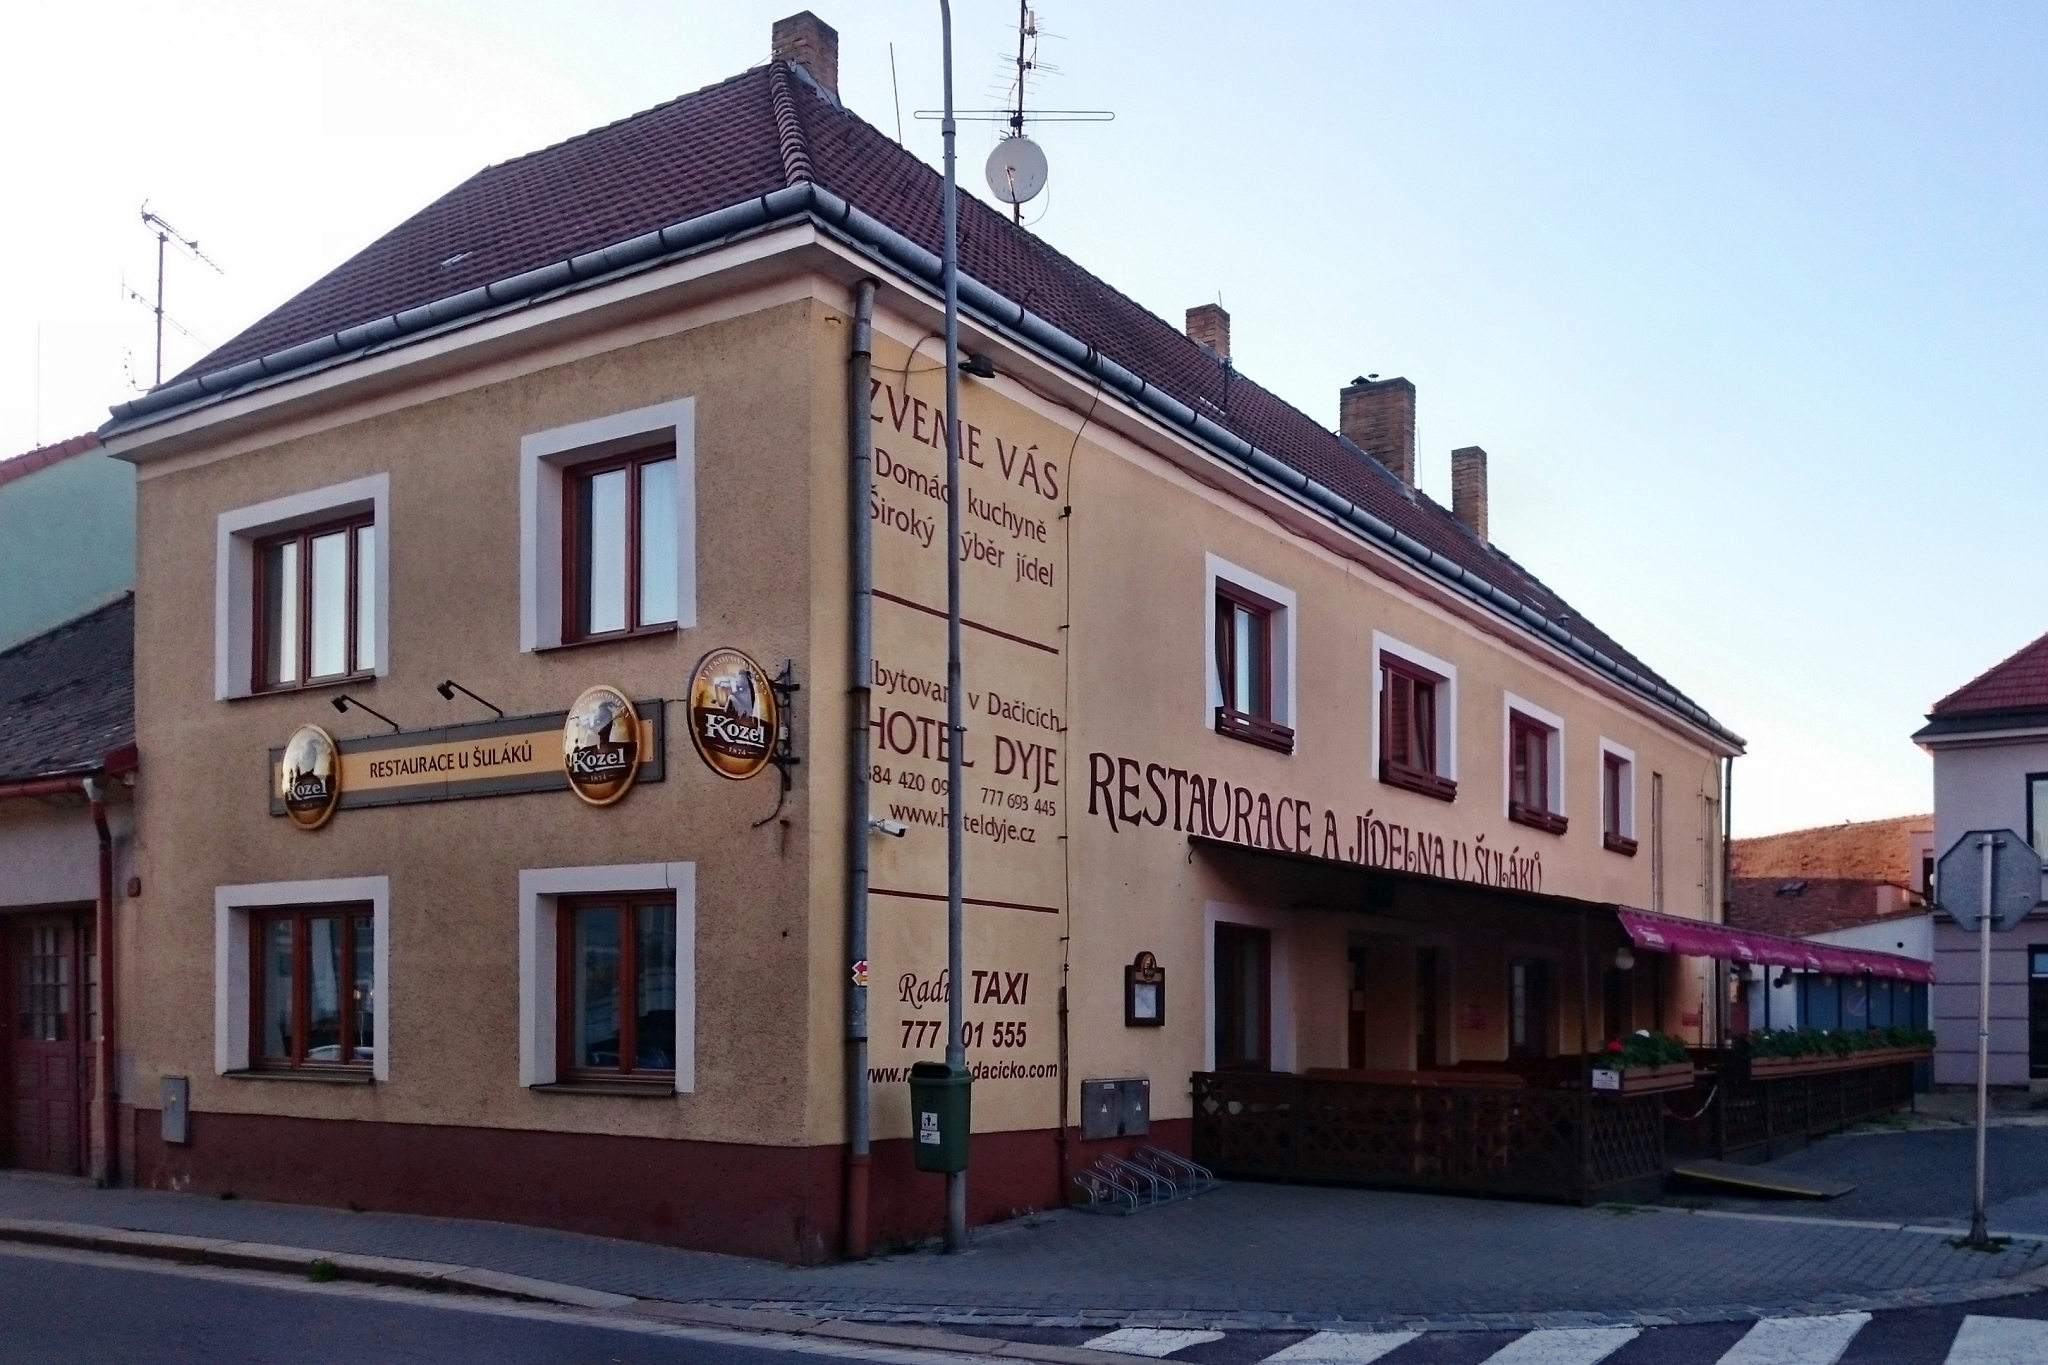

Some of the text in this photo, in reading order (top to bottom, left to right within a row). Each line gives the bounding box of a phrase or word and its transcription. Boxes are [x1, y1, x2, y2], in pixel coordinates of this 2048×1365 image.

[995, 437, 1059, 500] VÁS
[874, 447, 1047, 543] Domác kuchyně
[959, 530, 1005, 568] ýběr
[1015, 552, 1054, 587] jídel
[869, 658, 1062, 733] bytova v Dačicích
[704, 713, 765, 748] Kozel
[869, 706, 1060, 794] HOTEL DYJE
[369, 739, 533, 779] RESTAURACE U ŠULÁKŮ
[572, 747, 626, 774] Kozel
[287, 779, 328, 802] Kozel
[869, 764, 1056, 817] 84 420 09 777 693 445
[889, 803, 1036, 844] www.hteldyje.cz
[1088, 751, 1543, 894] RESTAURACE A JÍDELNA U ŠULÁKŮ
[899, 968, 1029, 1010] Radi TAXI
[901, 1020, 1027, 1049] 777 01 555
